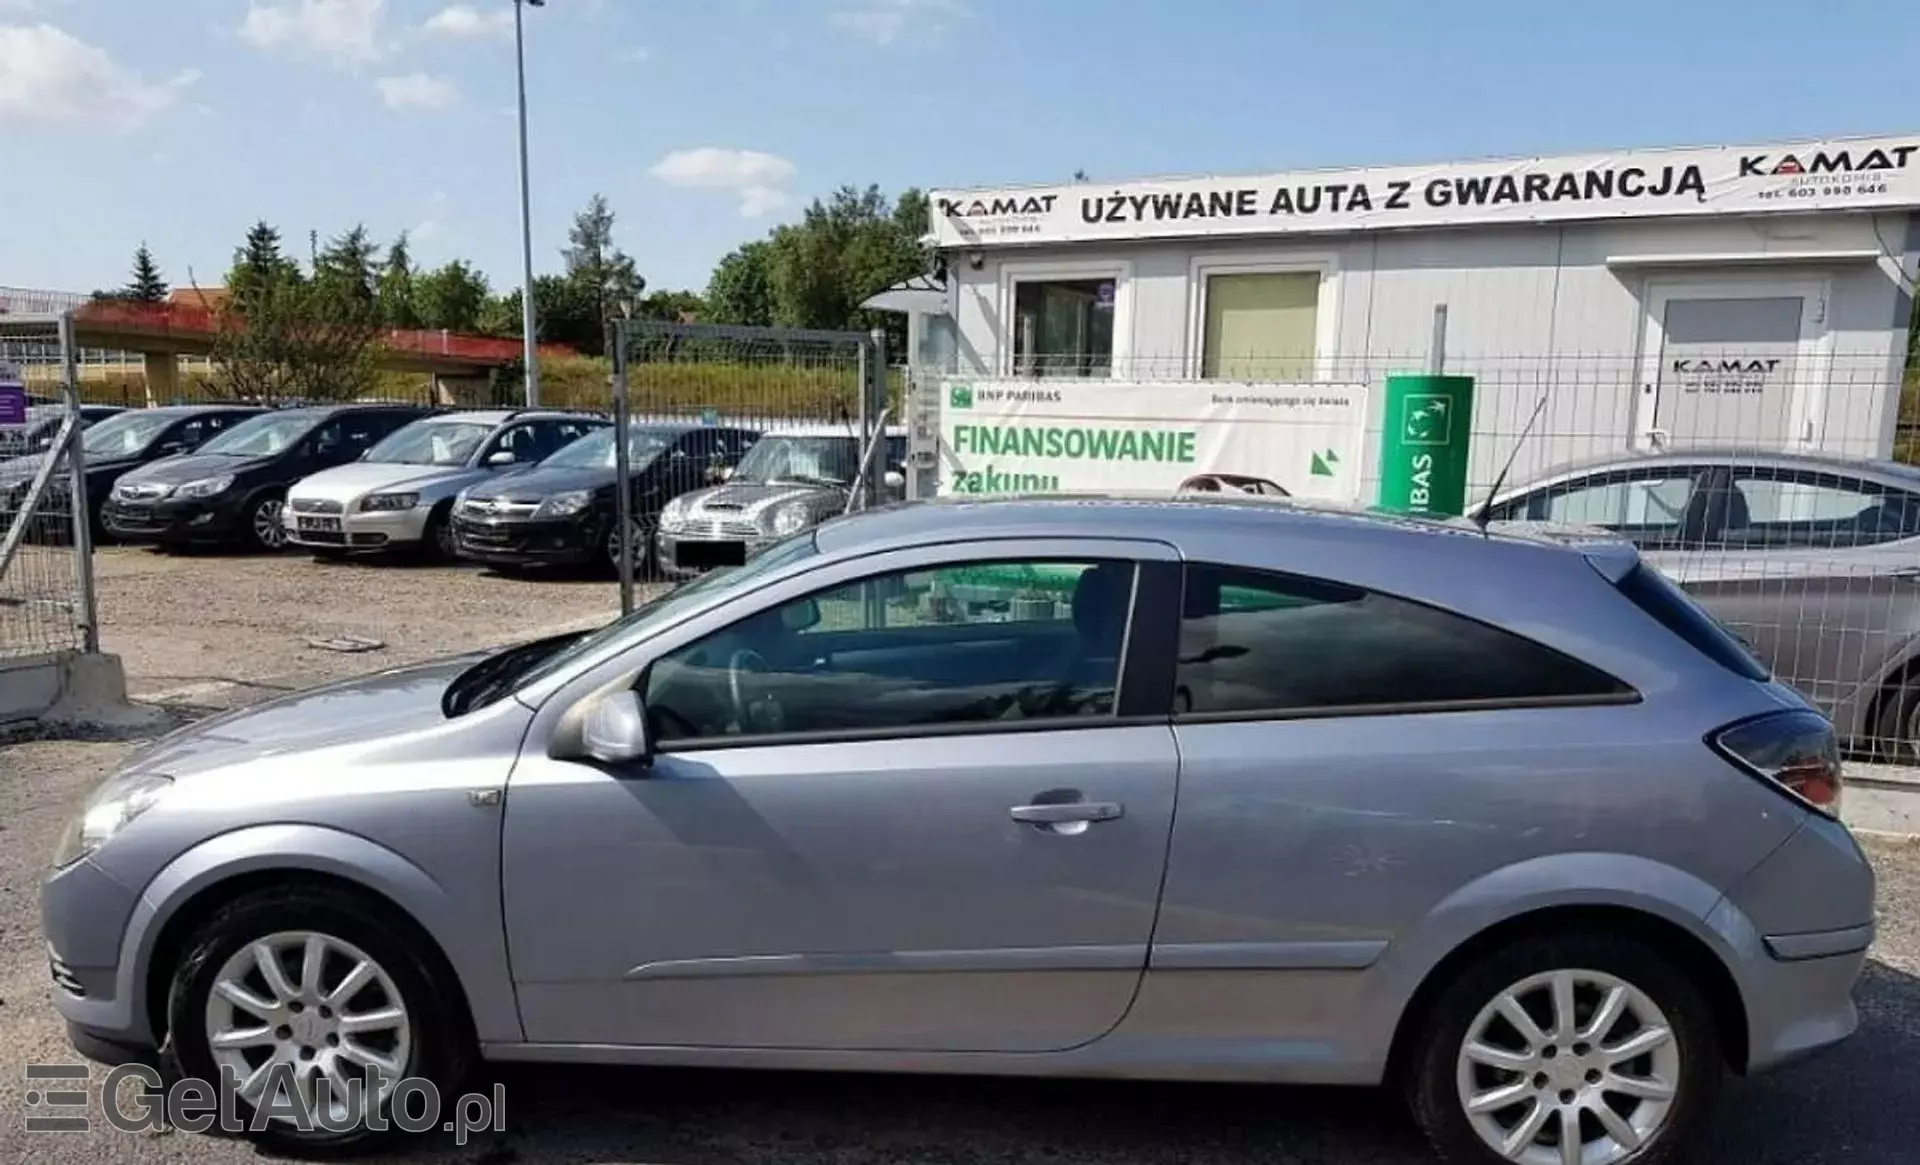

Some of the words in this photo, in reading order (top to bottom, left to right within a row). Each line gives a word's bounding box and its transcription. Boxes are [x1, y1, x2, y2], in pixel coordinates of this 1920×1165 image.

[1739, 146, 1920, 177] KAMAT
[944, 194, 1058, 217] KAMAT
[1081, 190, 1258, 224] UŻYWANE
[1269, 183, 1373, 214] AUTA
[1385, 181, 1411, 209] Z
[1424, 165, 1707, 207] GWARANCJĄ
[1673, 359, 1781, 374] KAMAT
[953, 425, 1197, 463] FINANSOWANIE
